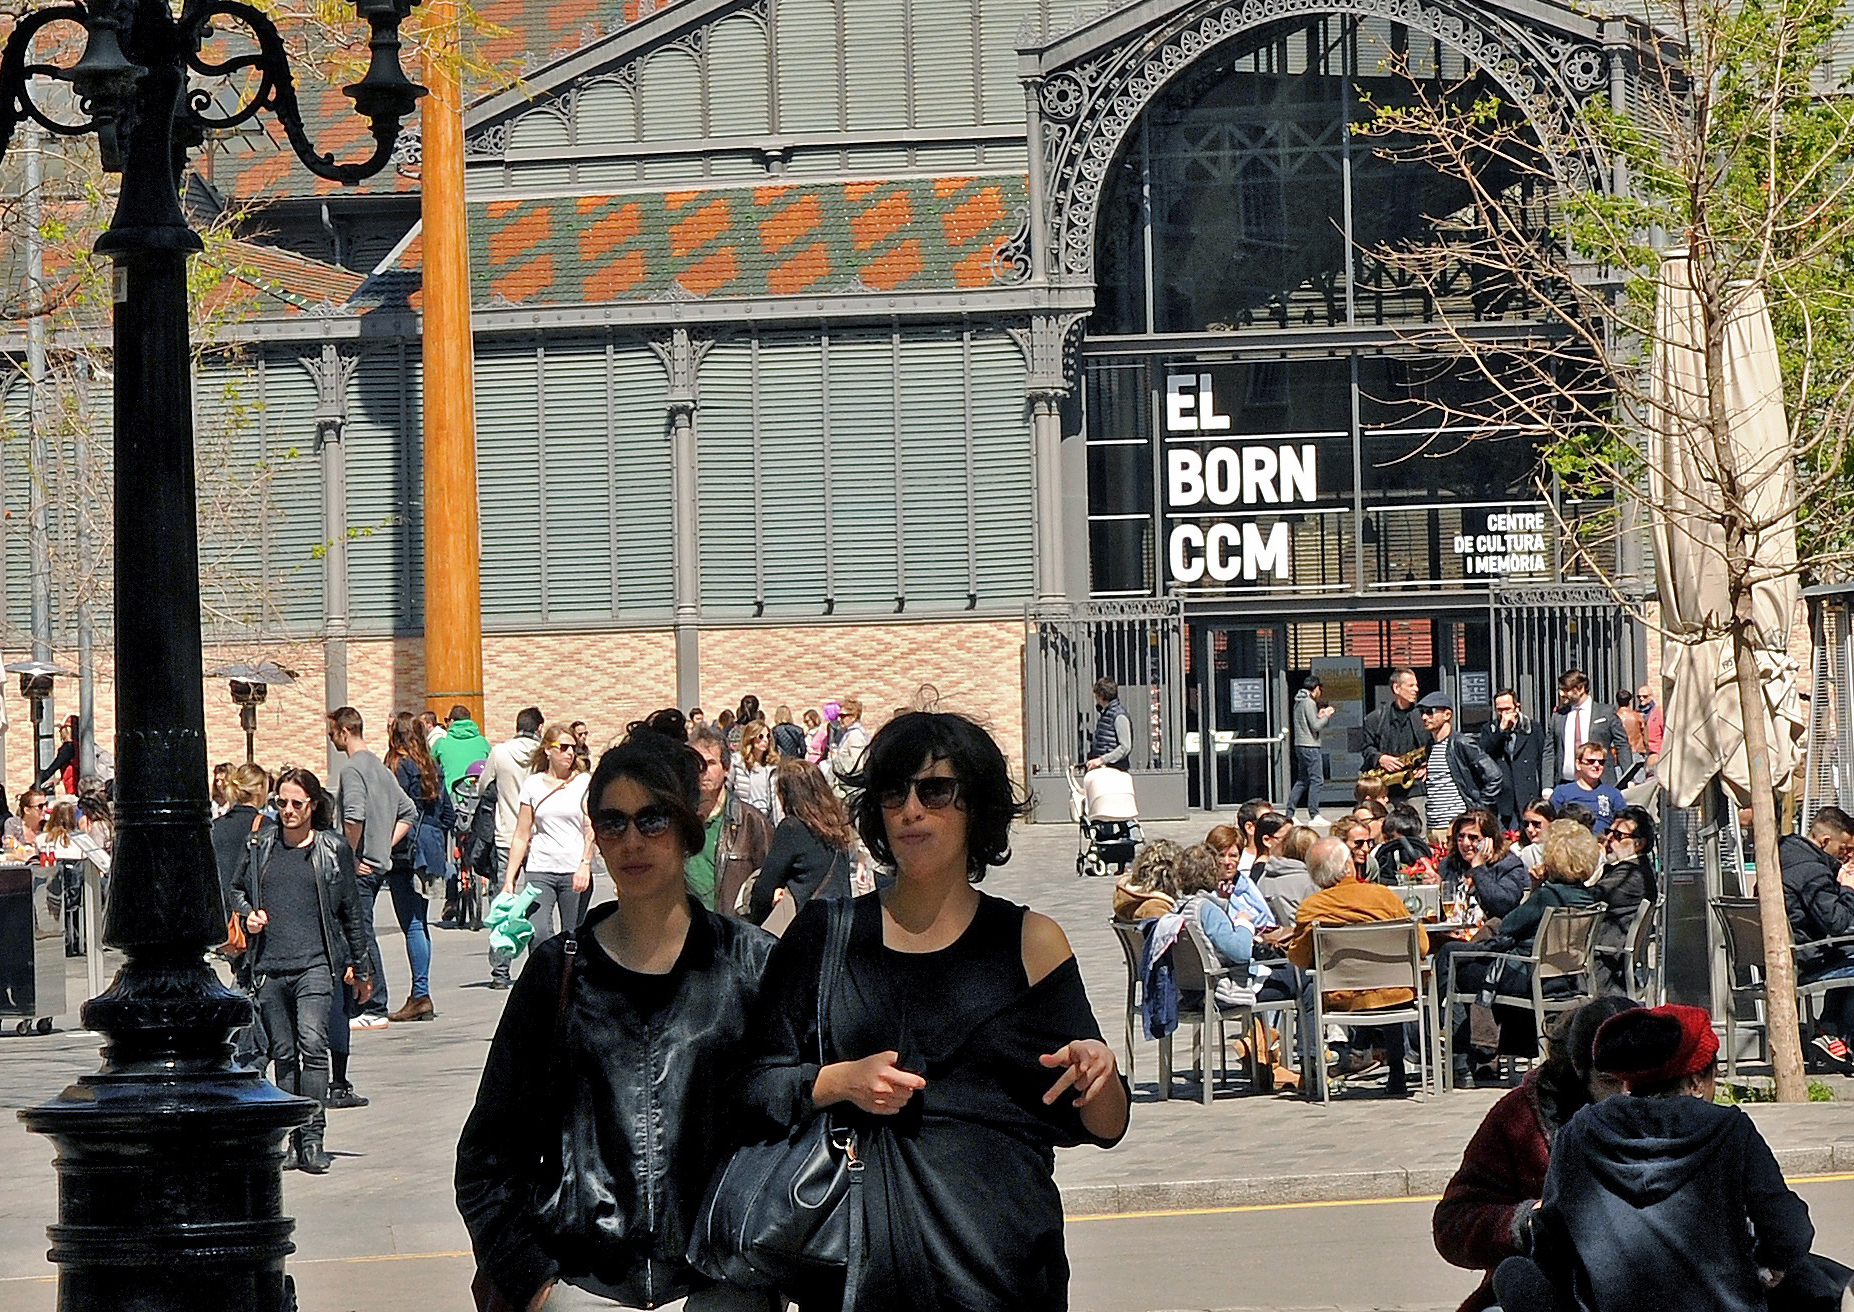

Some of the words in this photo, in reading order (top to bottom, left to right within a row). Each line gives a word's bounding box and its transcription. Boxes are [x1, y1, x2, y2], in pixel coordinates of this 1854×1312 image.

[1166, 373, 1231, 431] EL
[1167, 444, 1317, 507] BORN
[1487, 512, 1545, 532] CENTRE
[1169, 522, 1289, 583] CCM
[1454, 535, 1475, 554] DE
[1476, 533, 1546, 553] CULTURA
[1466, 556, 1473, 574] I
[1475, 552, 1546, 574] MEMÒRIA
